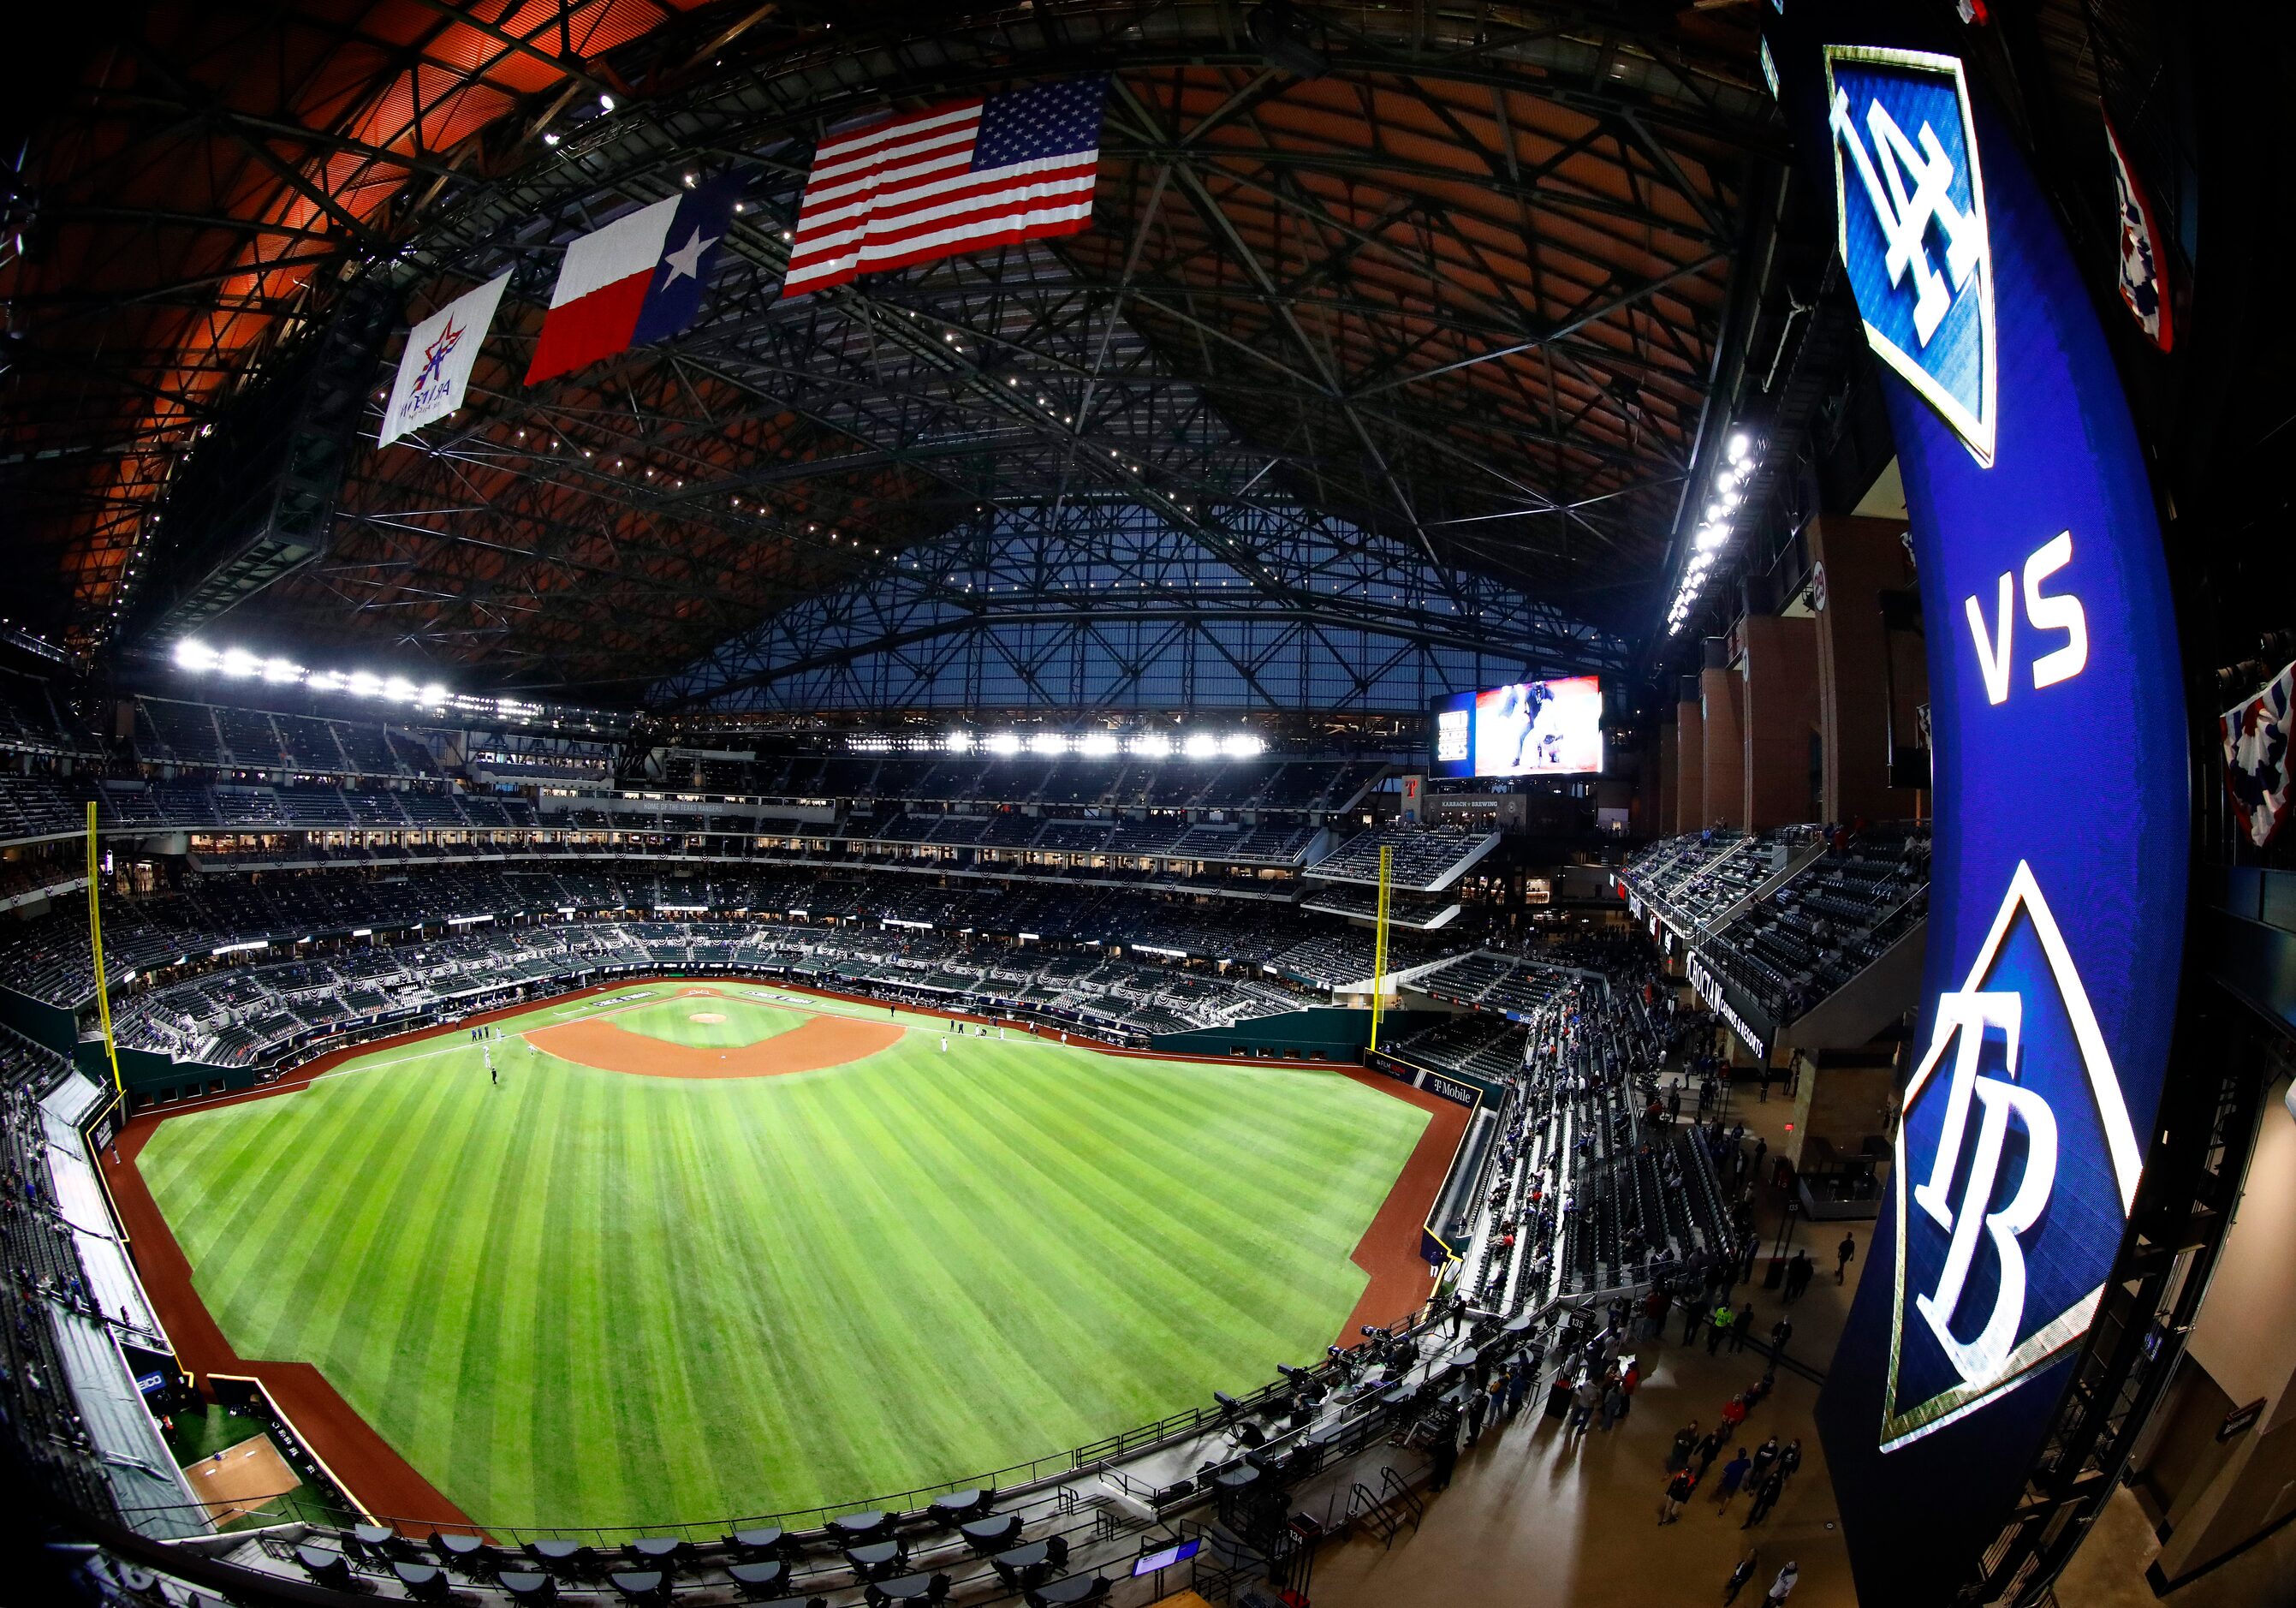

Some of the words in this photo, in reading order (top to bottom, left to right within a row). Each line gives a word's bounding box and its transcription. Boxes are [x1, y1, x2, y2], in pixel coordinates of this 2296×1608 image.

[1965, 529, 2089, 706] VS
[1405, 778, 1417, 799] T
[681, 804, 697, 813] TEXAS
[1686, 950, 1722, 1016] CHOCTAW
[1720, 998, 1738, 1028] CASINOS
[1740, 1021, 1764, 1059] RESORTS
[1572, 1318, 1585, 1329] 135
[137, 1375, 162, 1391] EICO
[1289, 1529, 1303, 1545] 134
